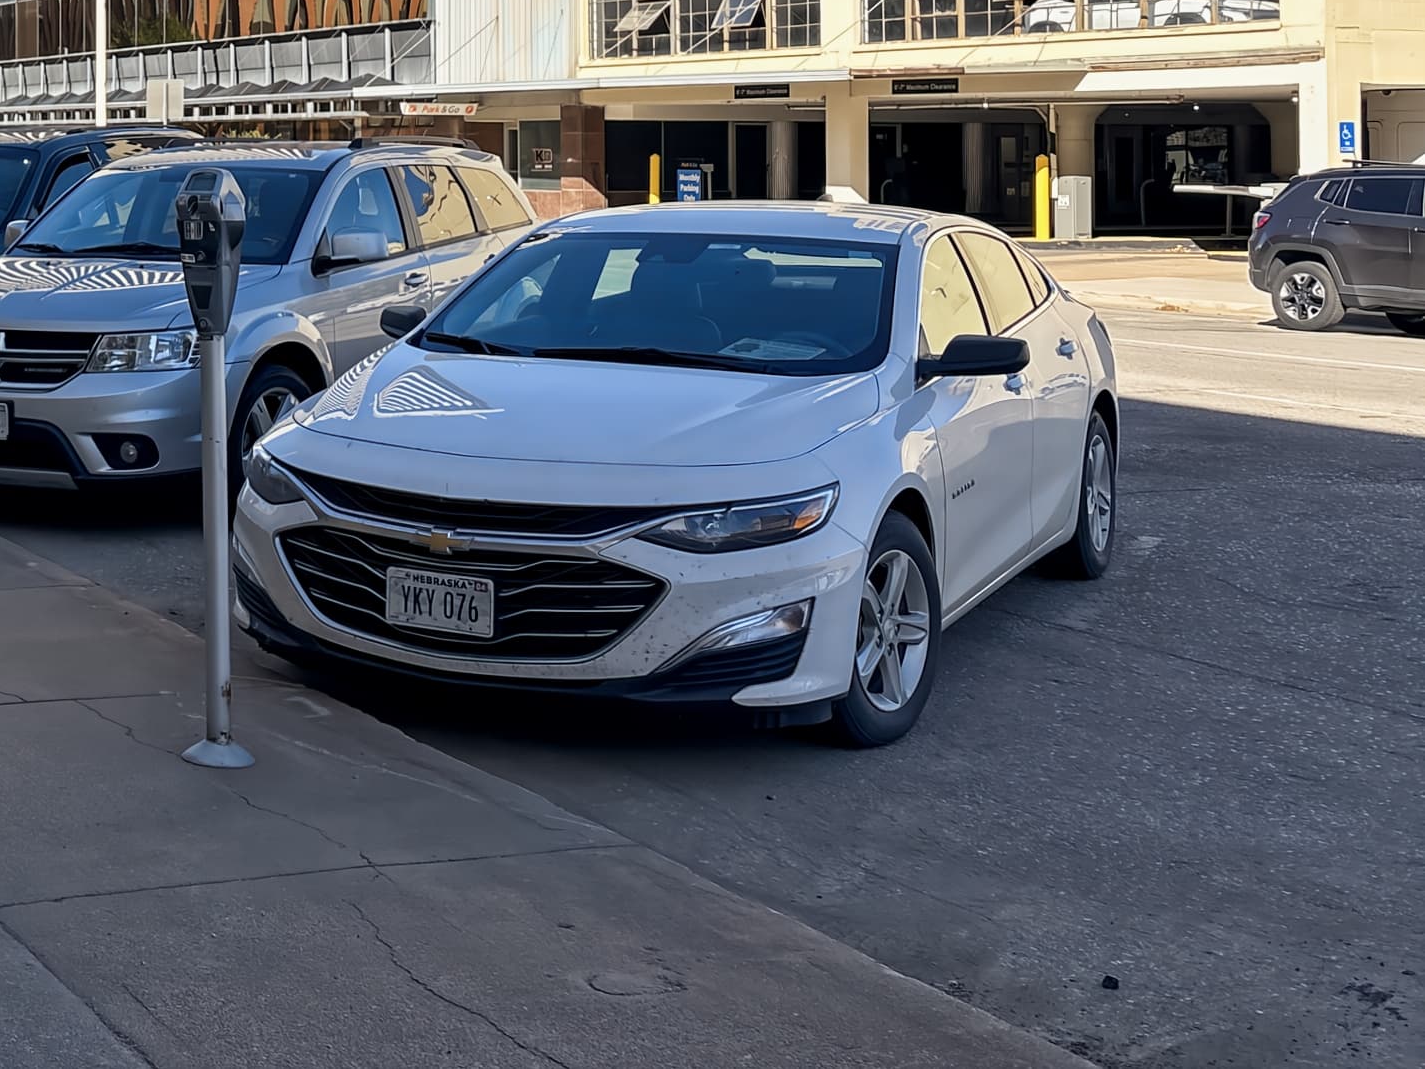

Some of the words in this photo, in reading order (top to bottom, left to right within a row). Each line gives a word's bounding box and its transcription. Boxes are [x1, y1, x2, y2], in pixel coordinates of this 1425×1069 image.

[422, 104, 440, 114] Park
[448, 105, 460, 114] Go
[680, 183, 699, 194] Parking
[412, 574, 467, 589] NEBRASKA
[401, 584, 435, 617] YKY
[443, 591, 479, 623] 076
